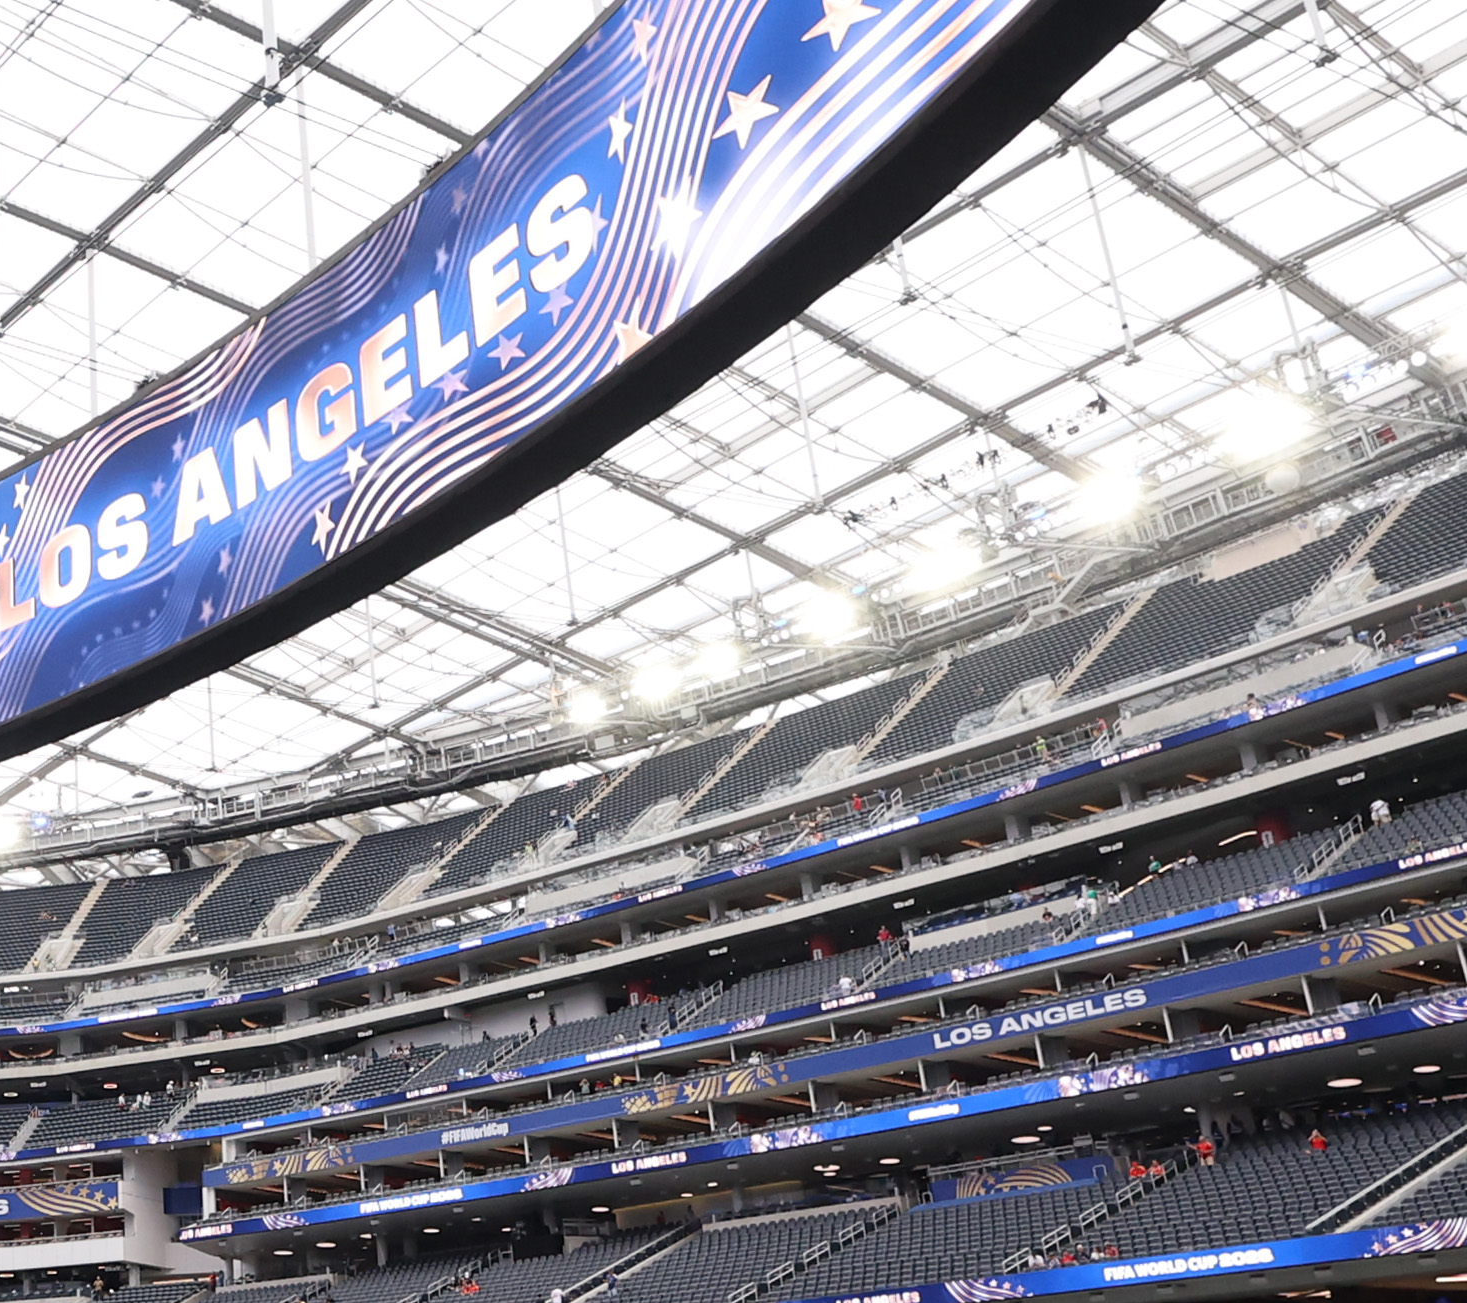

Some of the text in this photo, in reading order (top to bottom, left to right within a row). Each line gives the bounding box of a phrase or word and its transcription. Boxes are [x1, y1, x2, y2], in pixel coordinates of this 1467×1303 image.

[171, 172, 597, 547] ANGELES
[933, 989, 1147, 1048] LOS ANGELES
[1230, 1026, 1347, 1061] LOS ANGELES
[440, 1122, 509, 1145] #FIFAWorldCup
[635, 1151, 687, 1170] ANGELES
[1103, 1264, 1137, 1282] FIFA
[1133, 1258, 1189, 1278] WORLD
[1186, 1254, 1220, 1272] CUP
